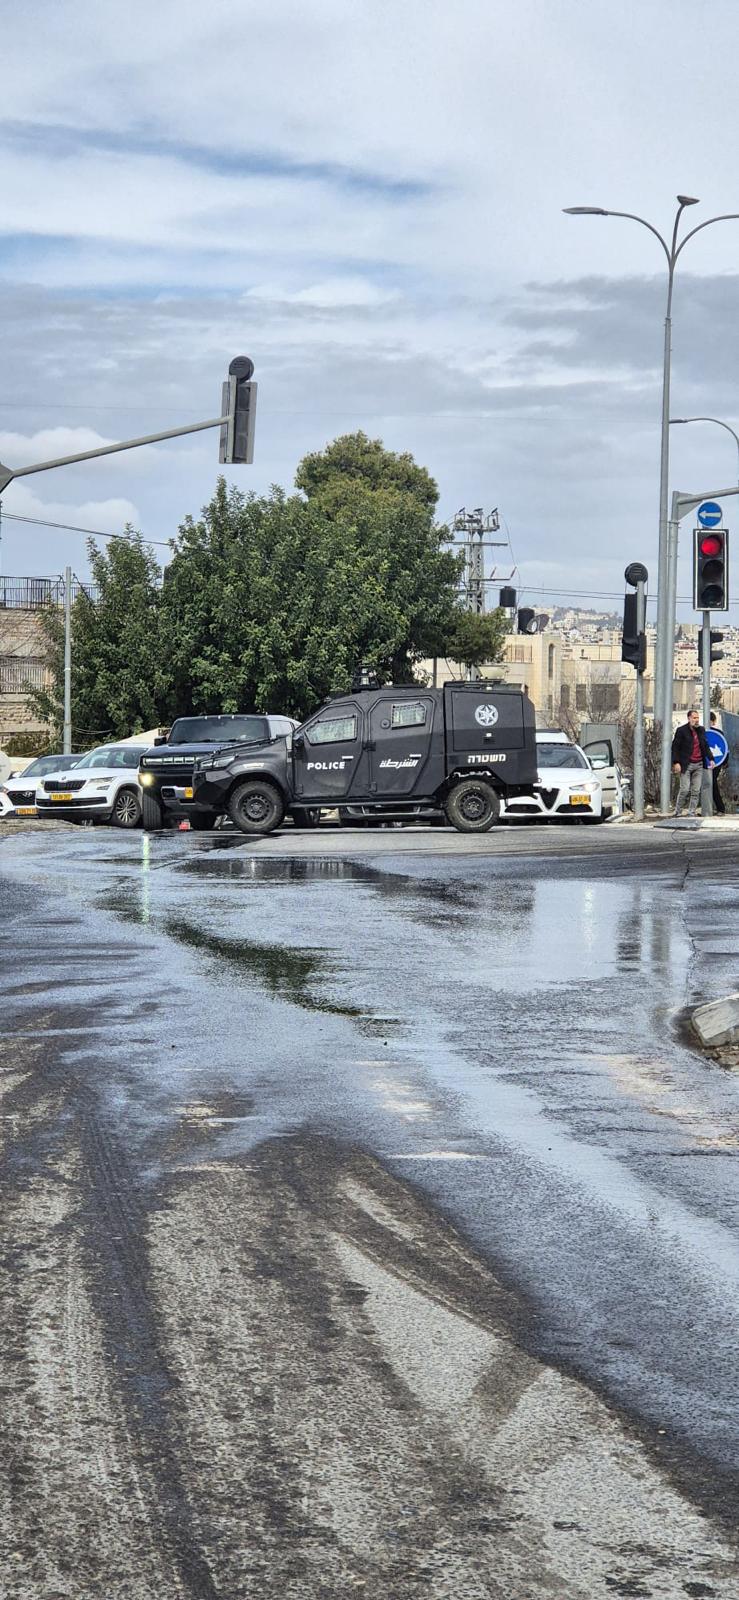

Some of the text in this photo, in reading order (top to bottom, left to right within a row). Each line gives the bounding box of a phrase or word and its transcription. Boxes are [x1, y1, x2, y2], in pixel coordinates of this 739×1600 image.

[467, 753, 506, 763] משטרה
[307, 761, 345, 770] POLICE
[379, 758, 419, 769] الشرطة
